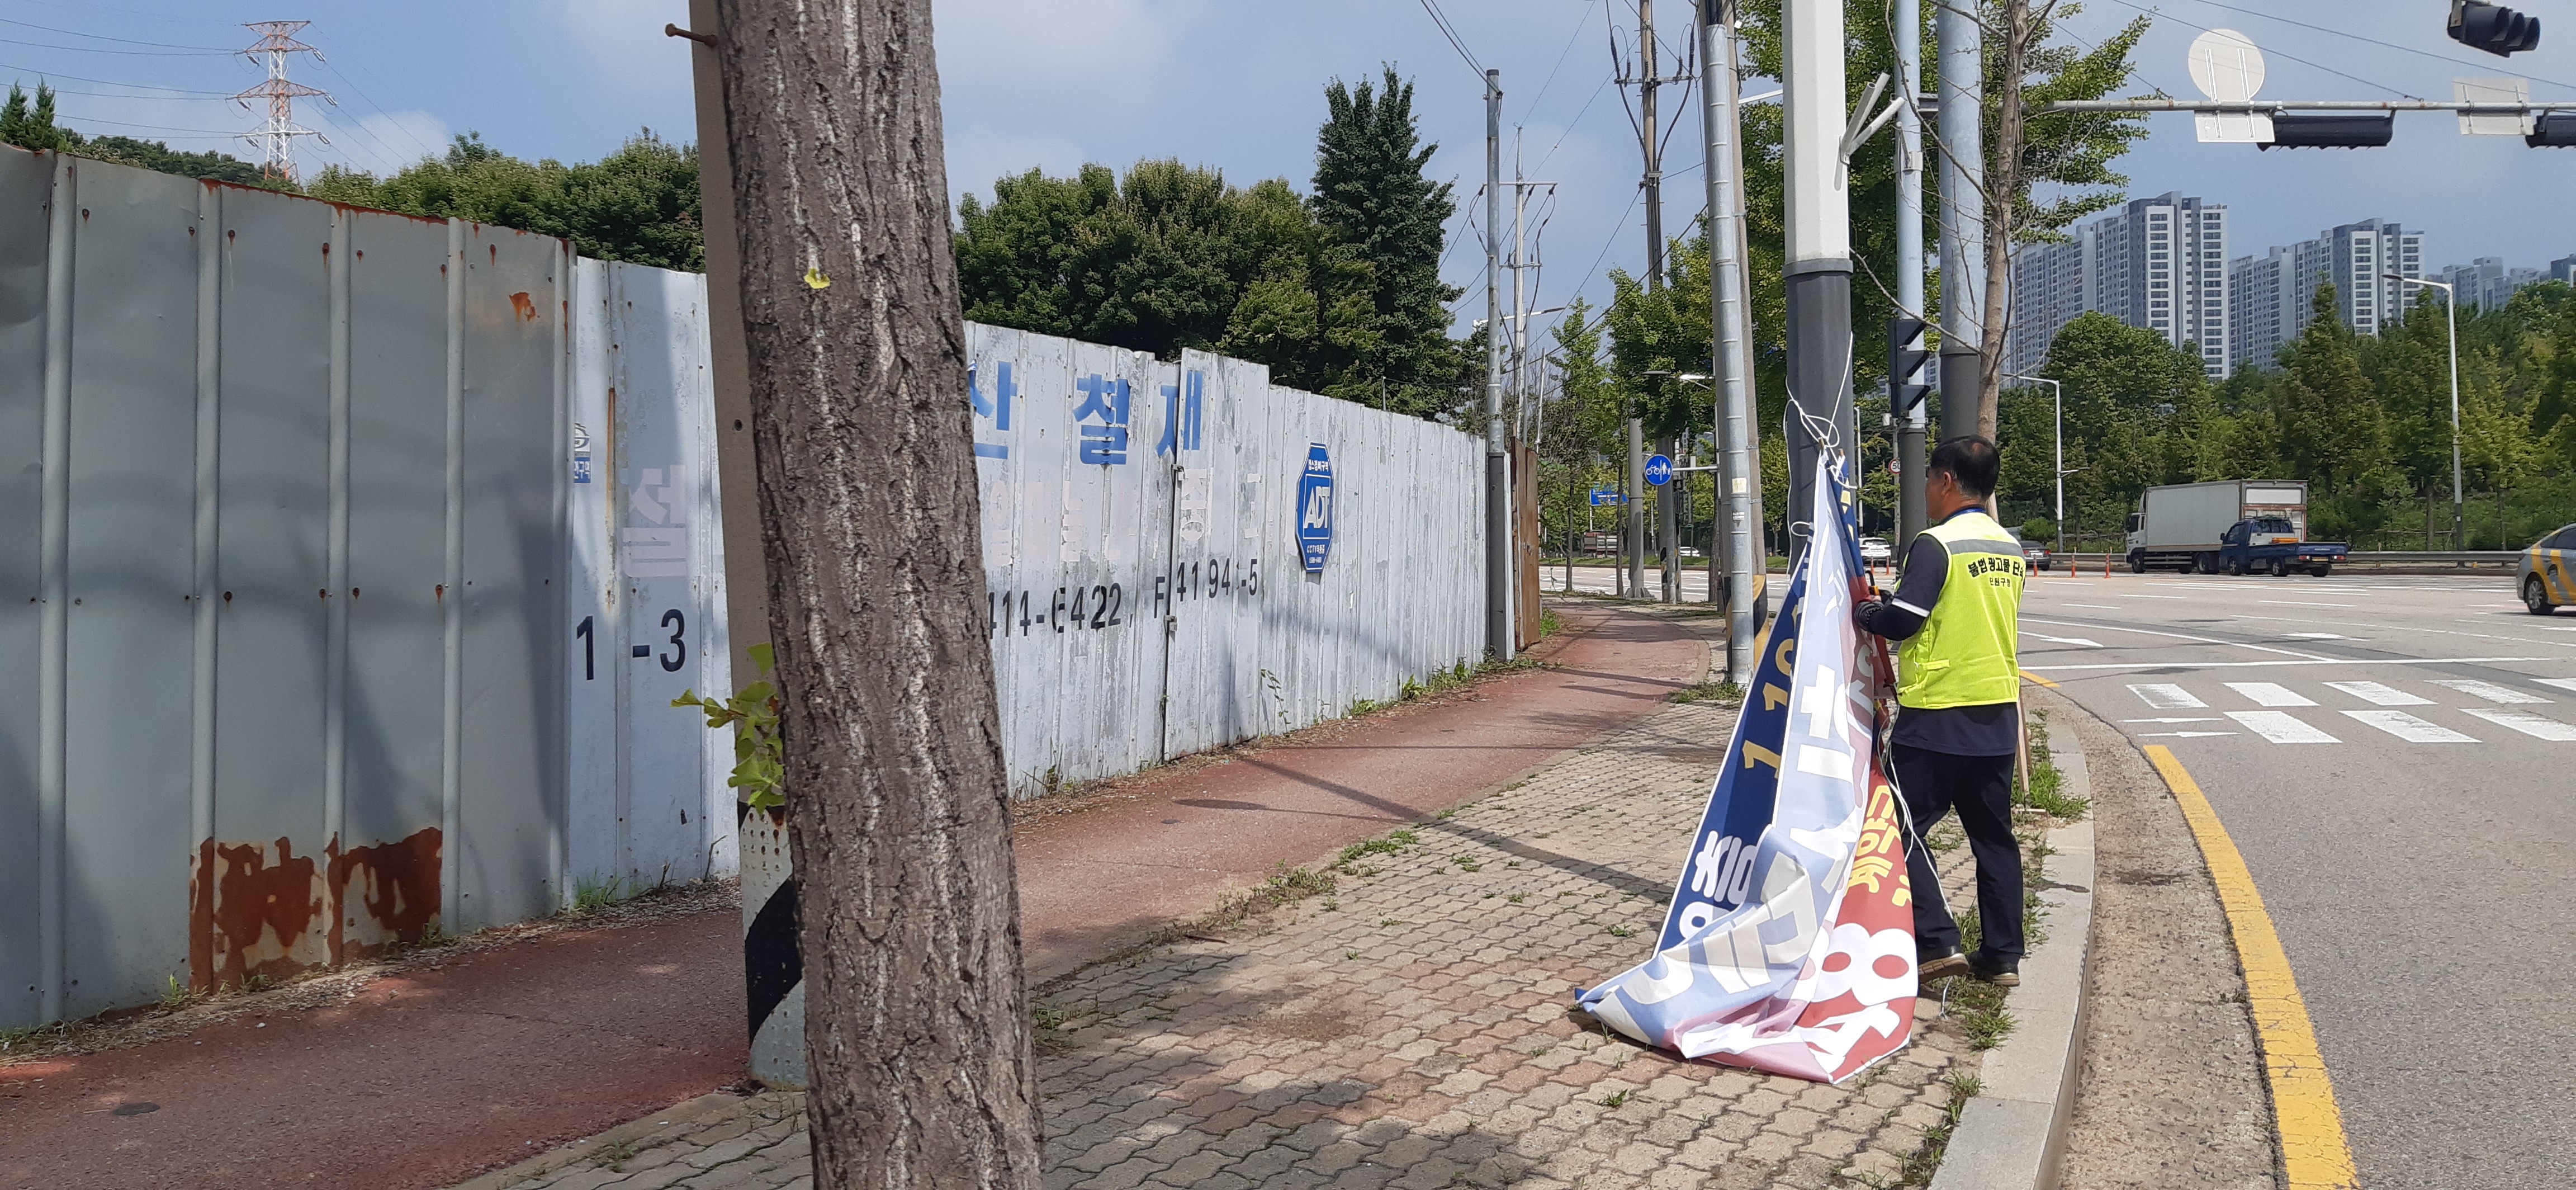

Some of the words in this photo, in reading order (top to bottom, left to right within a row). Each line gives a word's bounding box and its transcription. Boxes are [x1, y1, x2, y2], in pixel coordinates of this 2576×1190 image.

[1304, 486, 1330, 528] ADT
[1967, 557, 1988, 578] 불법
[1988, 557, 2010, 573] 광고물
